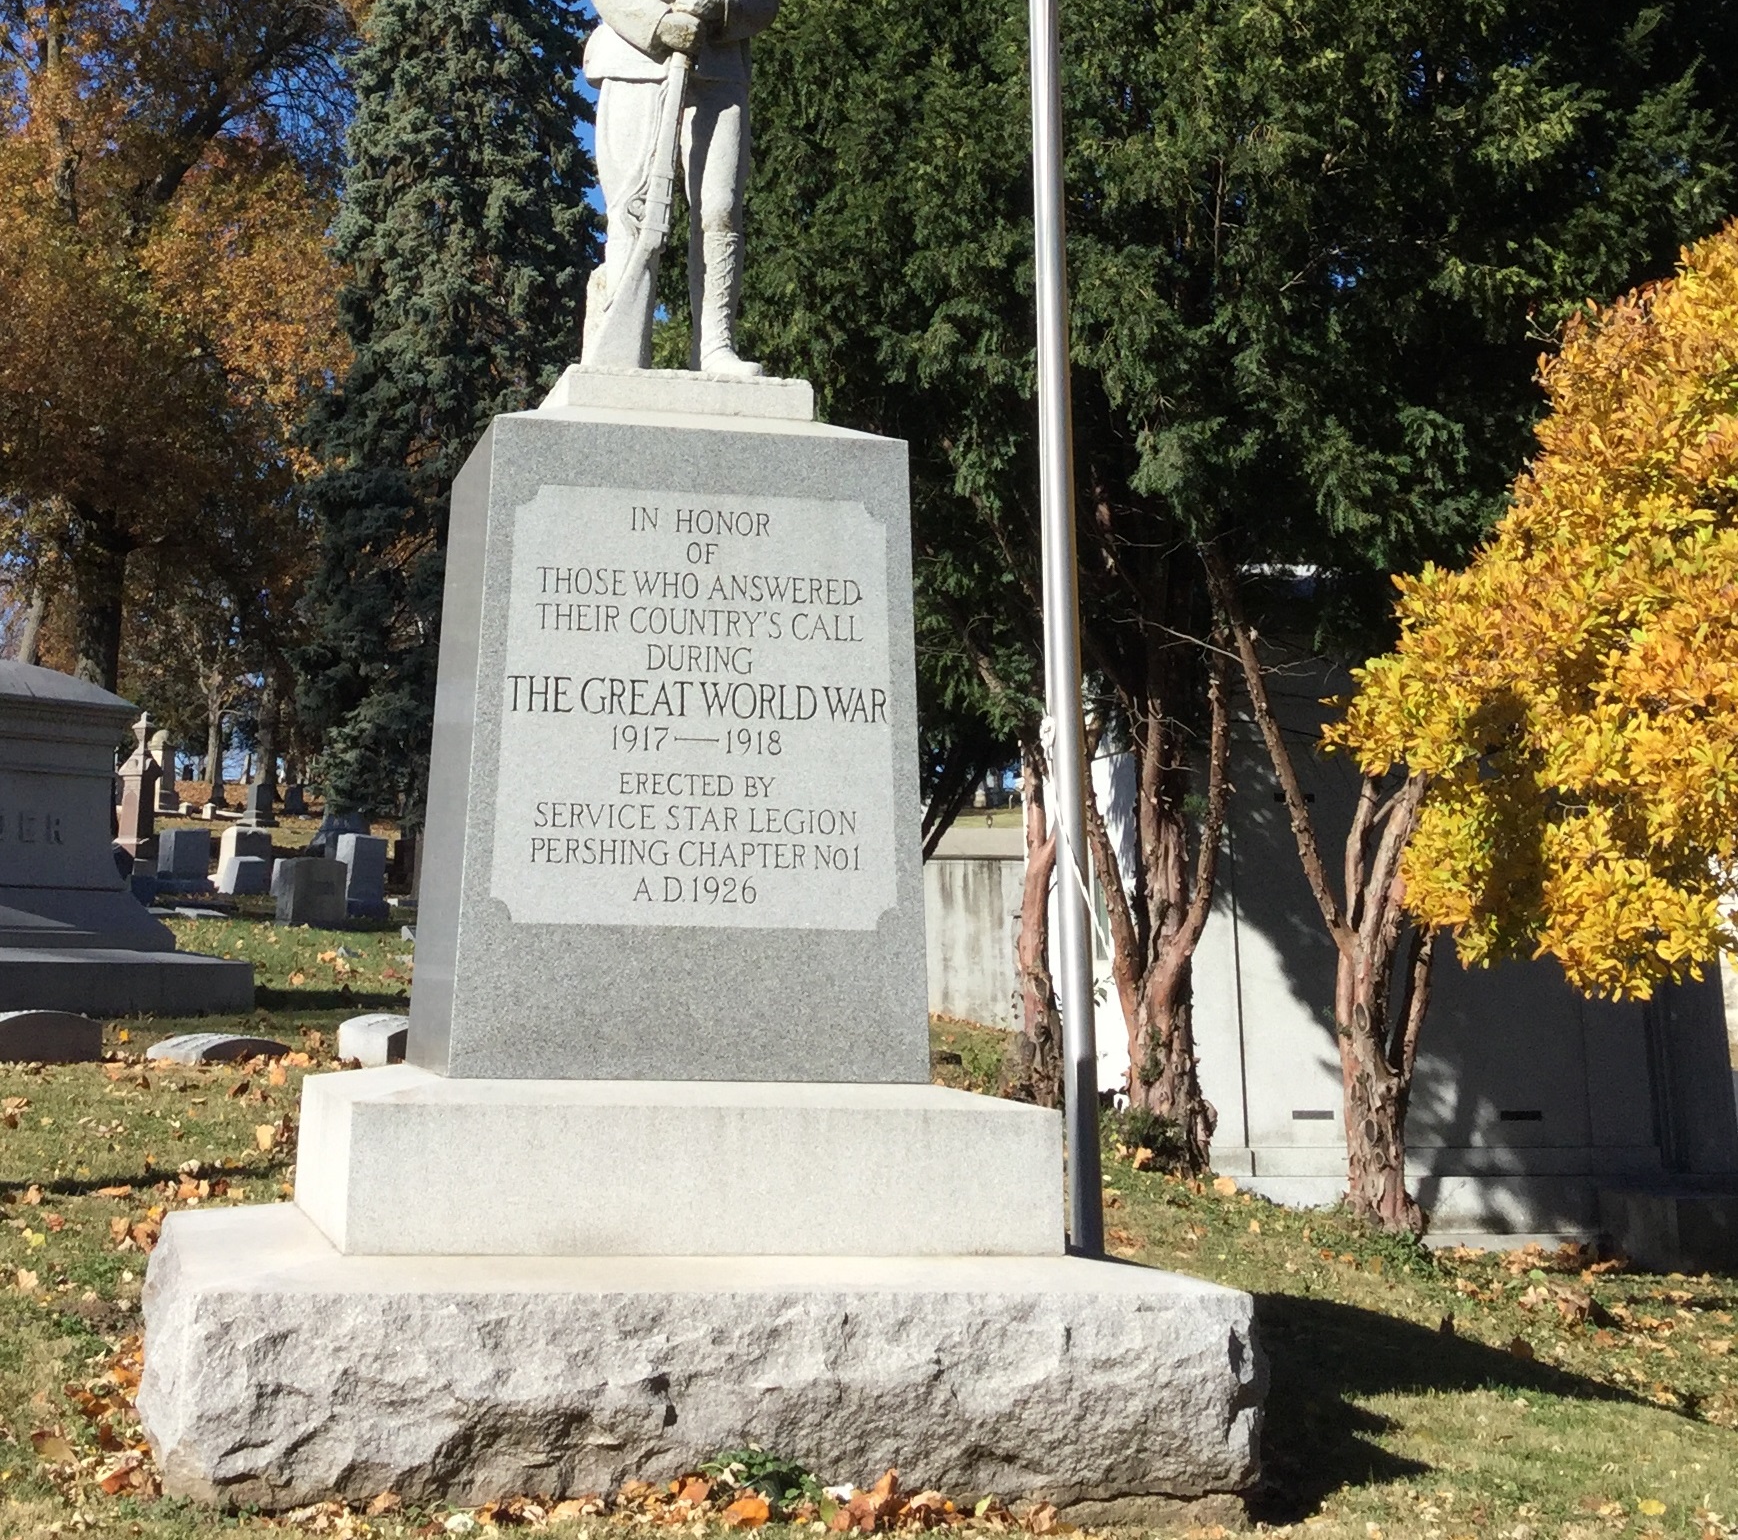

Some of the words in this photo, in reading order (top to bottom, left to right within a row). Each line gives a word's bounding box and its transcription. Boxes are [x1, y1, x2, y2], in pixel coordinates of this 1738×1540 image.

[630, 506, 659, 532] IN
[675, 509, 770, 537] HONOR
[686, 542, 719, 565] OF
[536, 566, 628, 597] THOSE
[633, 570, 699, 600] WHO
[707, 574, 863, 606] ANSWERED
[535, 602, 620, 633] THEIR
[629, 606, 782, 640] COUNTRY'S
[791, 612, 863, 642] CALL
[646, 643, 753, 675] DURING
[507, 675, 574, 713] THE
[580, 676, 693, 717] GREAT
[699, 681, 818, 721] WORLD
[822, 685, 888, 724] WAR
[619, 772, 734, 797] ERECTED
[744, 775, 776, 798] BY
[533, 801, 656, 831] SERVICE
[666, 805, 739, 833] STAR
[749, 808, 857, 836] LEGION
[530, 837, 669, 867] PERSHING
[678, 840, 806, 870] CHAPTER
